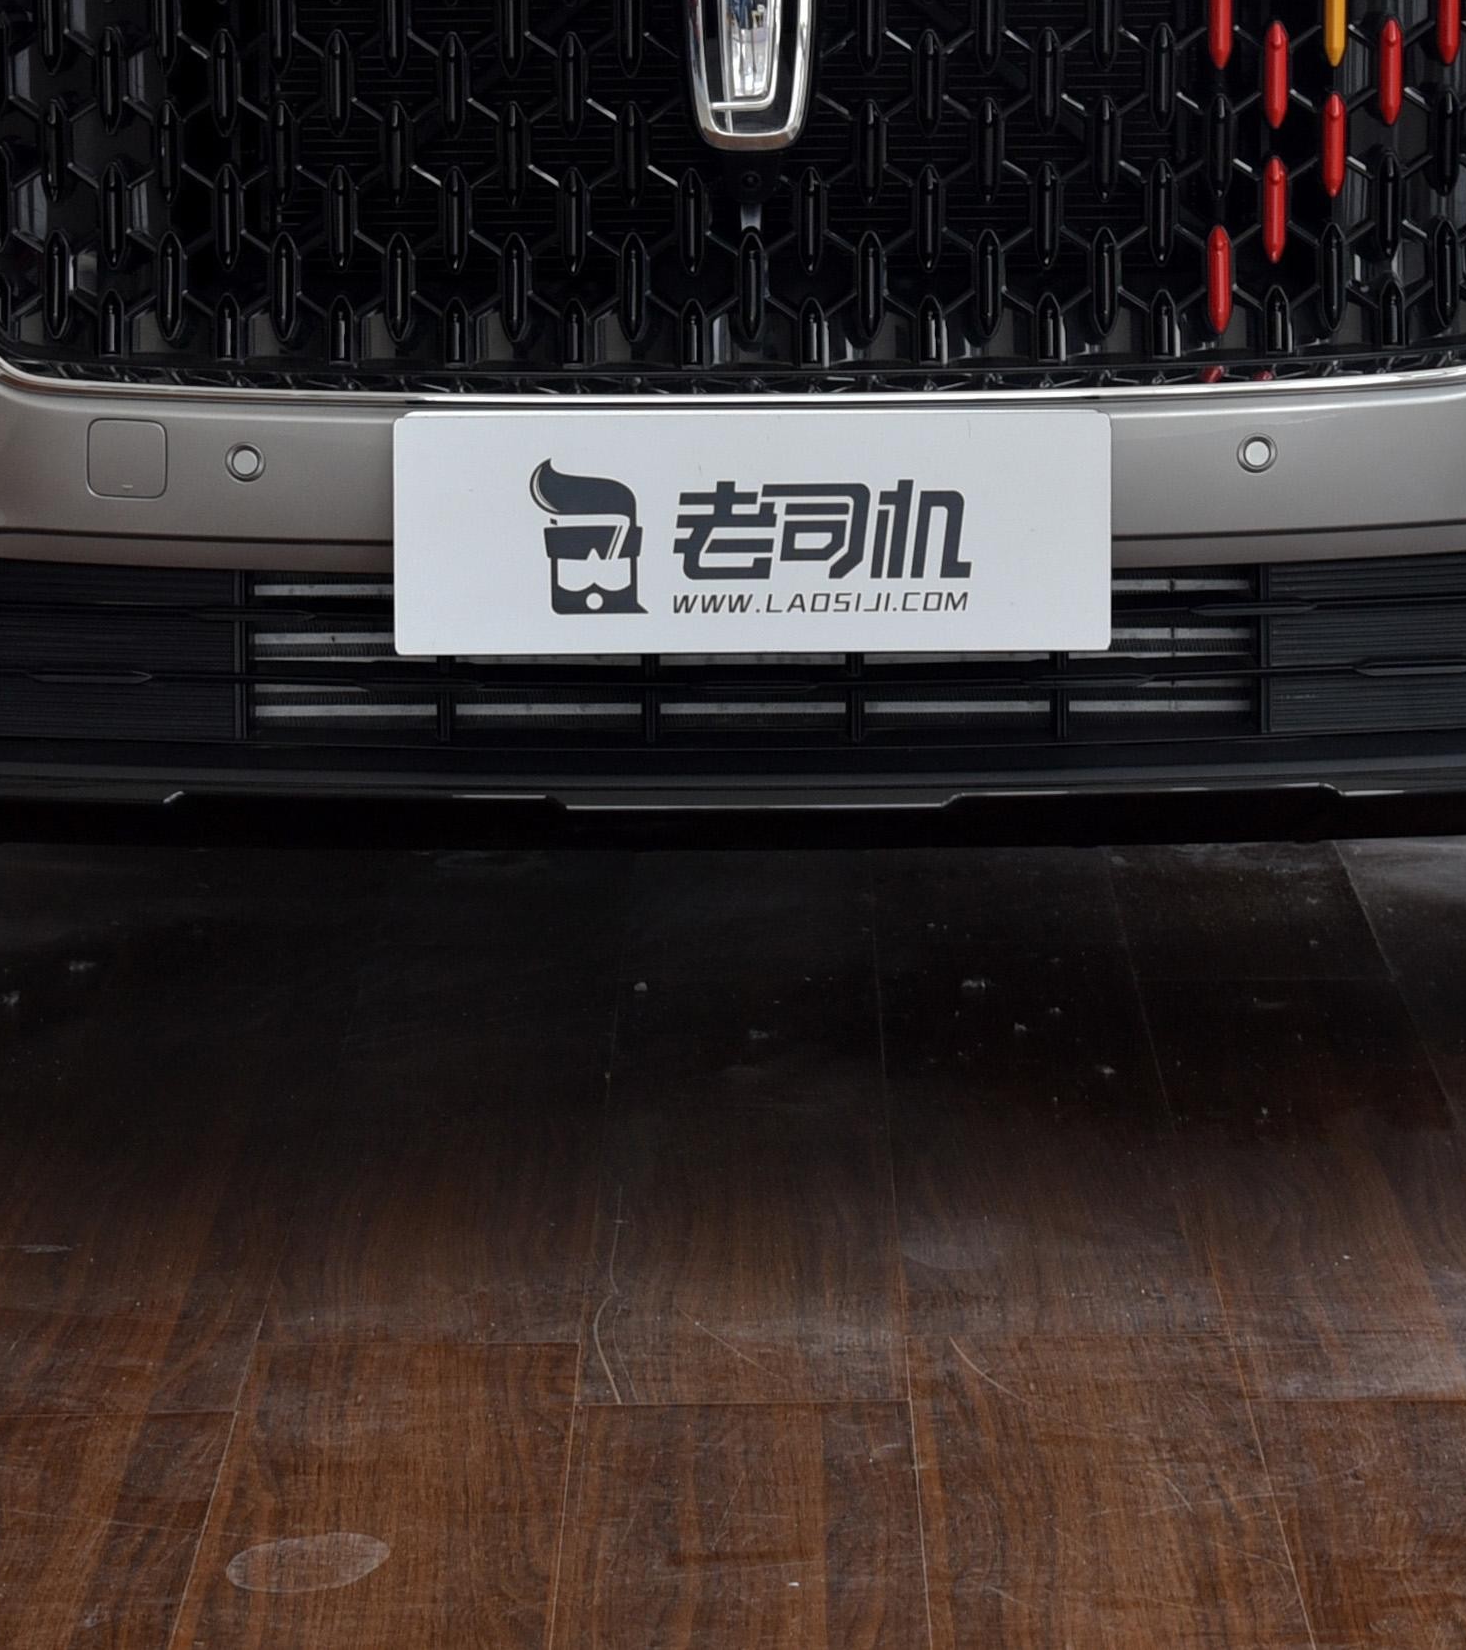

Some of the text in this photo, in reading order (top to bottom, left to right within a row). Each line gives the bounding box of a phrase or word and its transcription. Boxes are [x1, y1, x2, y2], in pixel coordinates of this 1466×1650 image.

[673, 479, 972, 580] 老司机
[673, 591, 969, 614] WWW.LAOSIJI.COM
